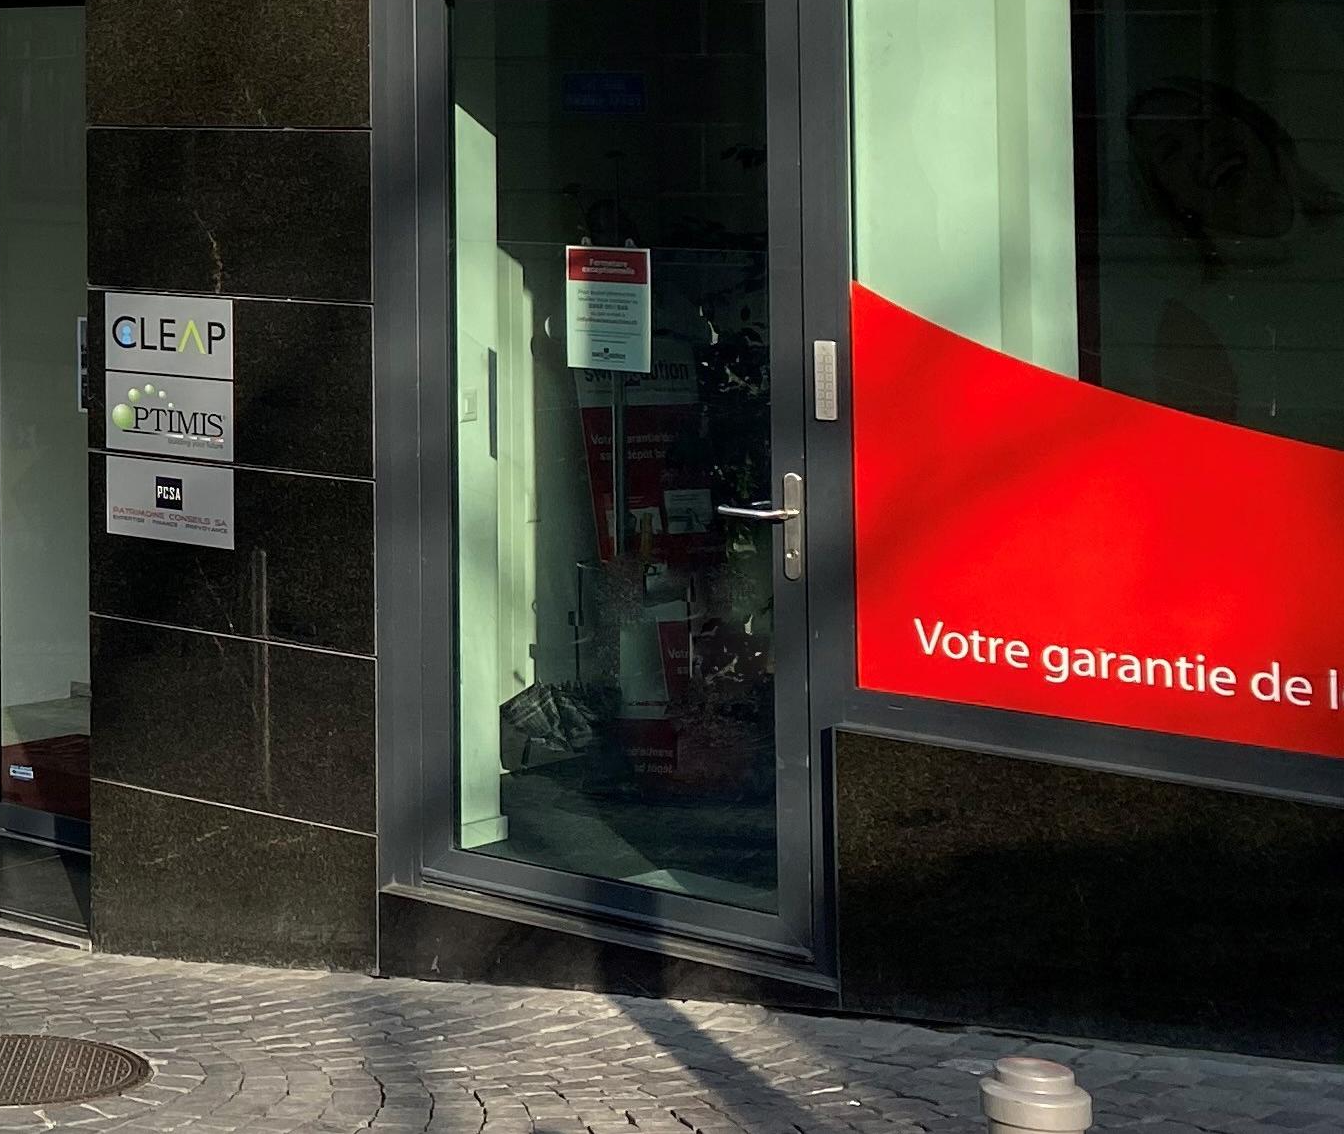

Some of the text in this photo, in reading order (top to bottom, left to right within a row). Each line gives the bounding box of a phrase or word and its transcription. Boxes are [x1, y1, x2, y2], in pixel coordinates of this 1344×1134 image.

[112, 315, 226, 355] CLEAP
[157, 485, 181, 501] PCSA
[168, 513, 211, 525] CONSEILS
[214, 518, 228, 527] SA
[912, 617, 1344, 711] Votre garantie de l
